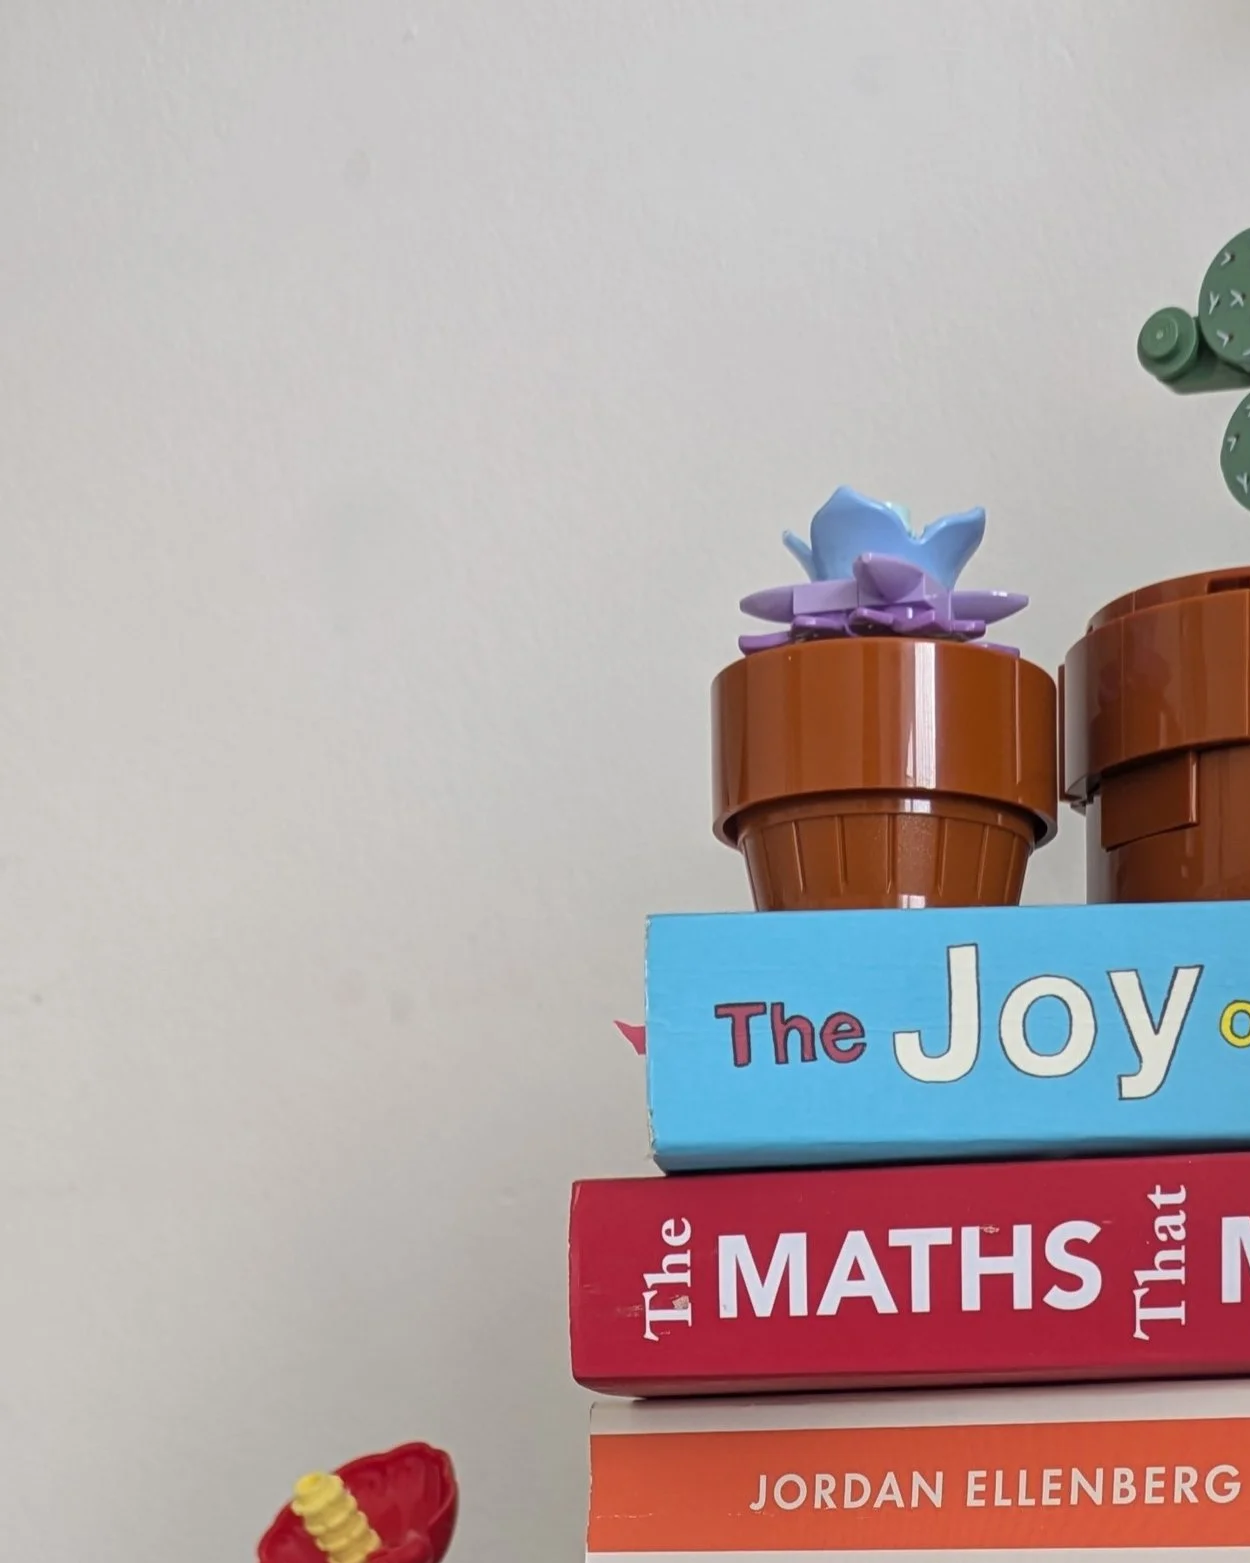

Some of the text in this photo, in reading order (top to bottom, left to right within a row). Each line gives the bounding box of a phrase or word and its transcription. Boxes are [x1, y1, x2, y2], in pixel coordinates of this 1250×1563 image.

[714, 1001, 867, 1068] The
[892, 942, 1204, 1101] Joy
[643, 1217, 692, 1341] The
[718, 1220, 1102, 1318] MATHS
[1132, 1184, 1187, 1341] That
[749, 1471, 944, 1512] JORDAN
[966, 1464, 1241, 1507] ELLENBERG
